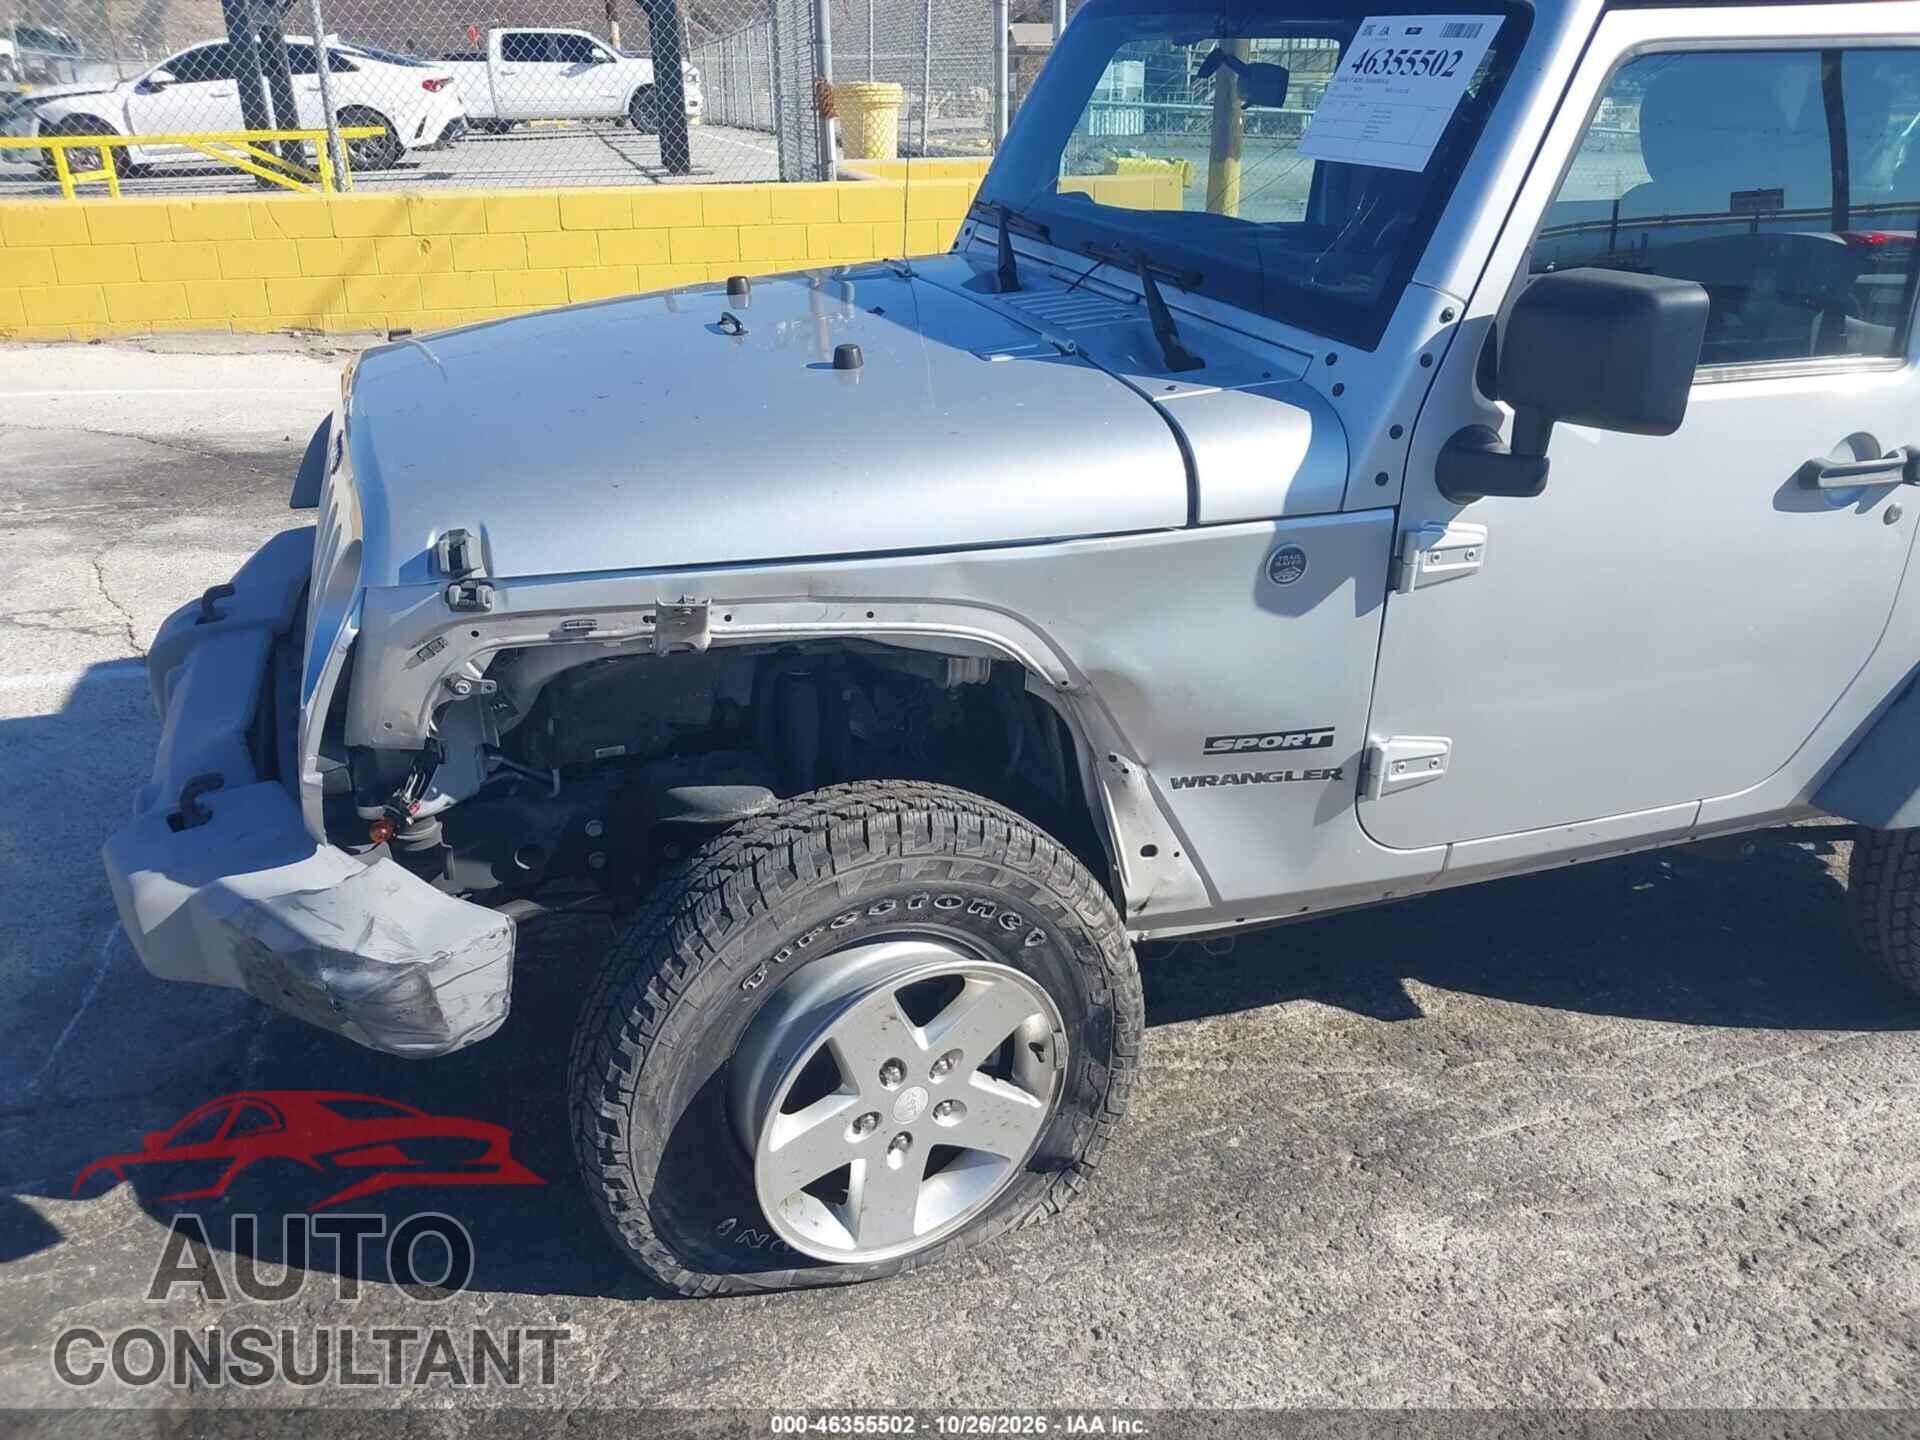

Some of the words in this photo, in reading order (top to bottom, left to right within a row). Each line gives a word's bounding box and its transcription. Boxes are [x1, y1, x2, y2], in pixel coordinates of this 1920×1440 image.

[1352, 48, 1464, 78] 46355502
[1205, 728, 1334, 755] SPORT
[1170, 768, 1343, 790] WRANGLER
